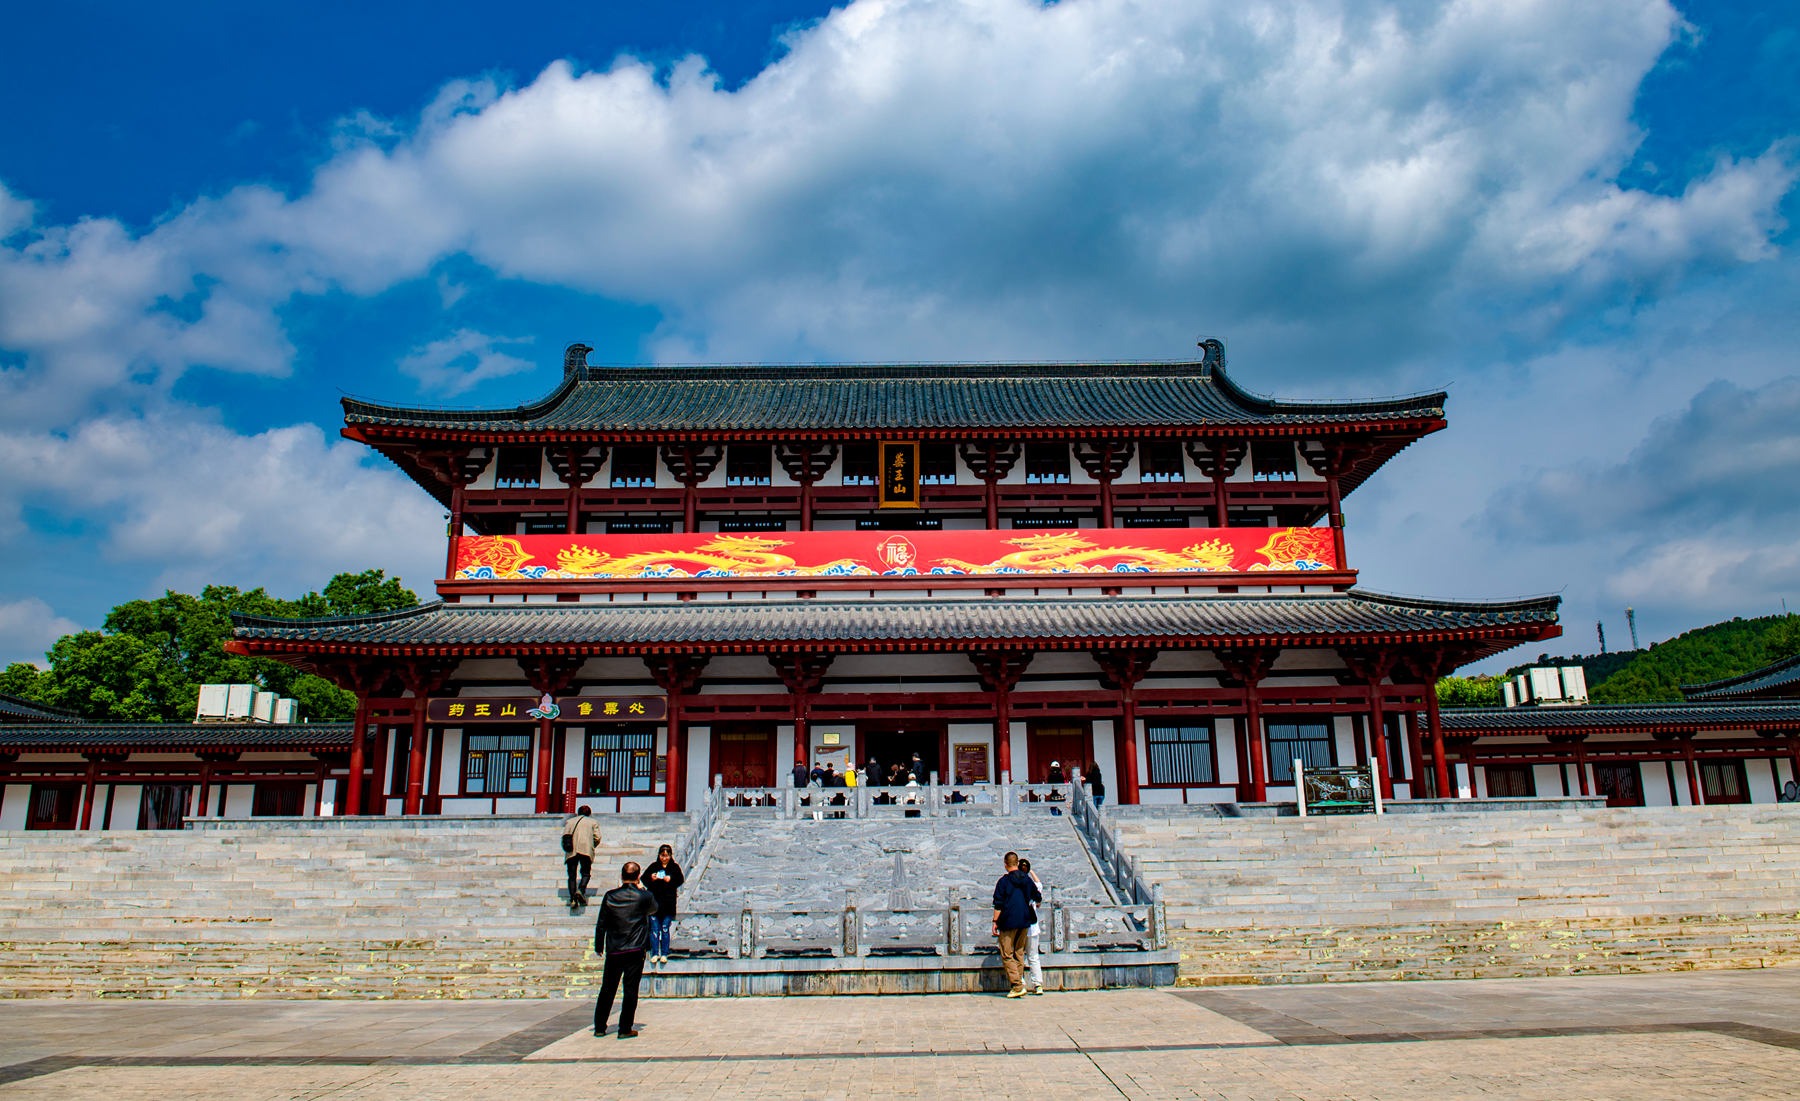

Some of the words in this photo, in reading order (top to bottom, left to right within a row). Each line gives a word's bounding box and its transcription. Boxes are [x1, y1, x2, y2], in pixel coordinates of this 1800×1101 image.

[886, 543, 913, 565] 福
[448, 703, 517, 717] 药王山
[577, 701, 646, 716] 售票处
